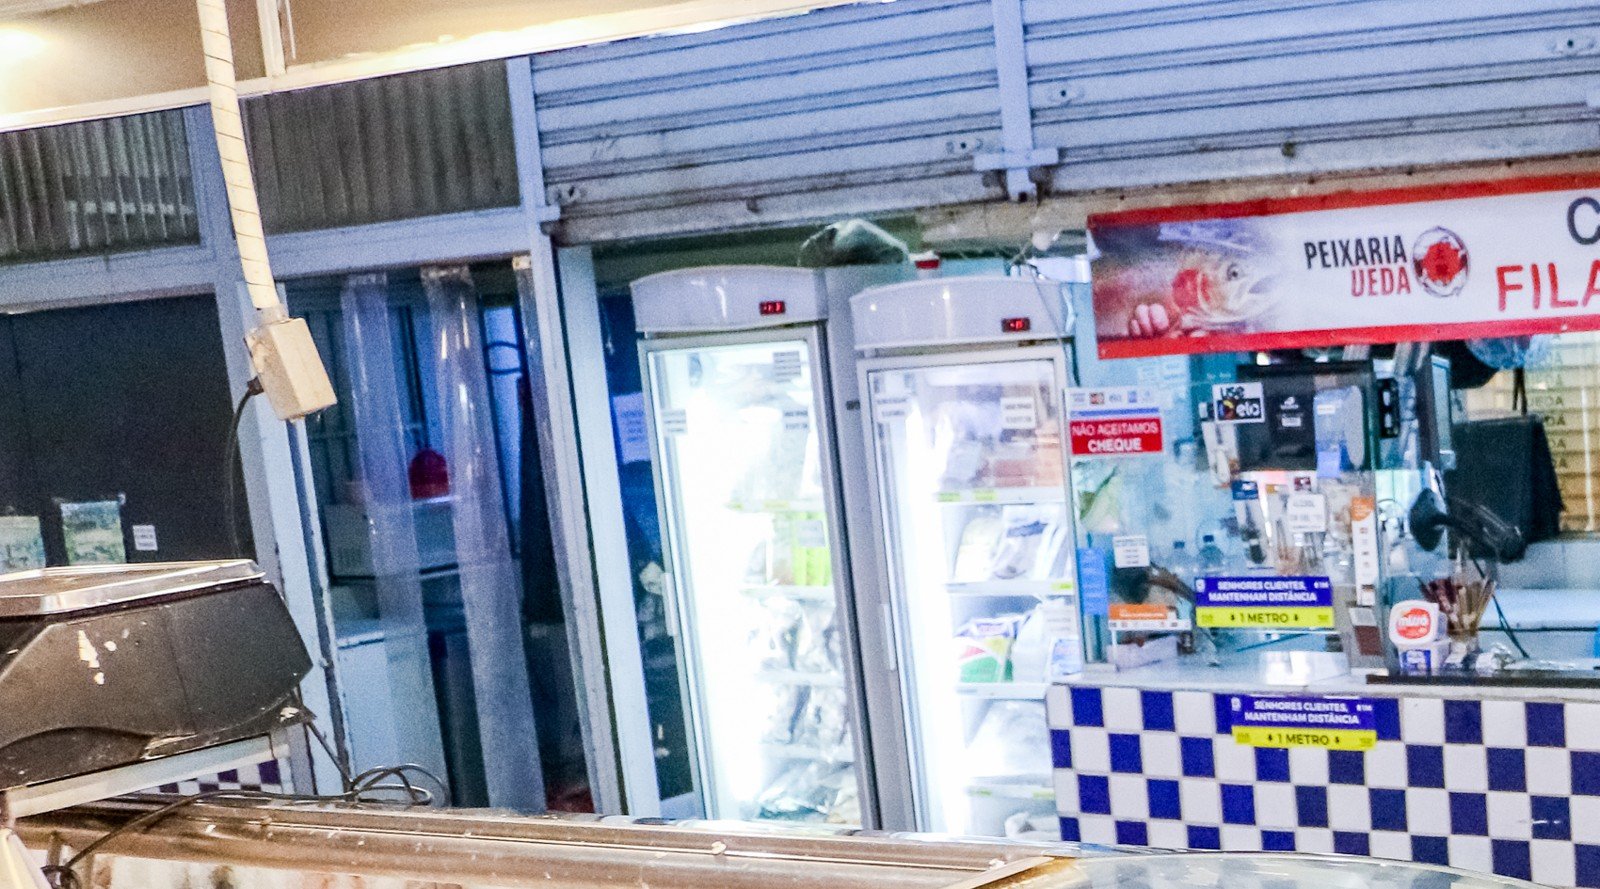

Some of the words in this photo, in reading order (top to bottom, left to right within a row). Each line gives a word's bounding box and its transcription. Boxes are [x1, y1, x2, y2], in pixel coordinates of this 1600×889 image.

[1303, 235, 1408, 270] PEIXARIA
[1350, 266, 1412, 297] UEDA
[1071, 422, 1096, 436] NÃO
[1097, 421, 1159, 436] ACEITAMOS
[1087, 437, 1143, 453] CHEQUE
[1217, 581, 1263, 590] SENHORES
[1208, 592, 1267, 602] MANTENHAM
[1268, 590, 1318, 602] DISTÂNCIA
[1247, 613, 1289, 624] METRO
[1253, 701, 1303, 711] SENHORES
[1244, 712, 1307, 723] MANTENHAM
[1307, 712, 1360, 724] DISTÂNCIA
[1285, 734, 1330, 745] METRO
